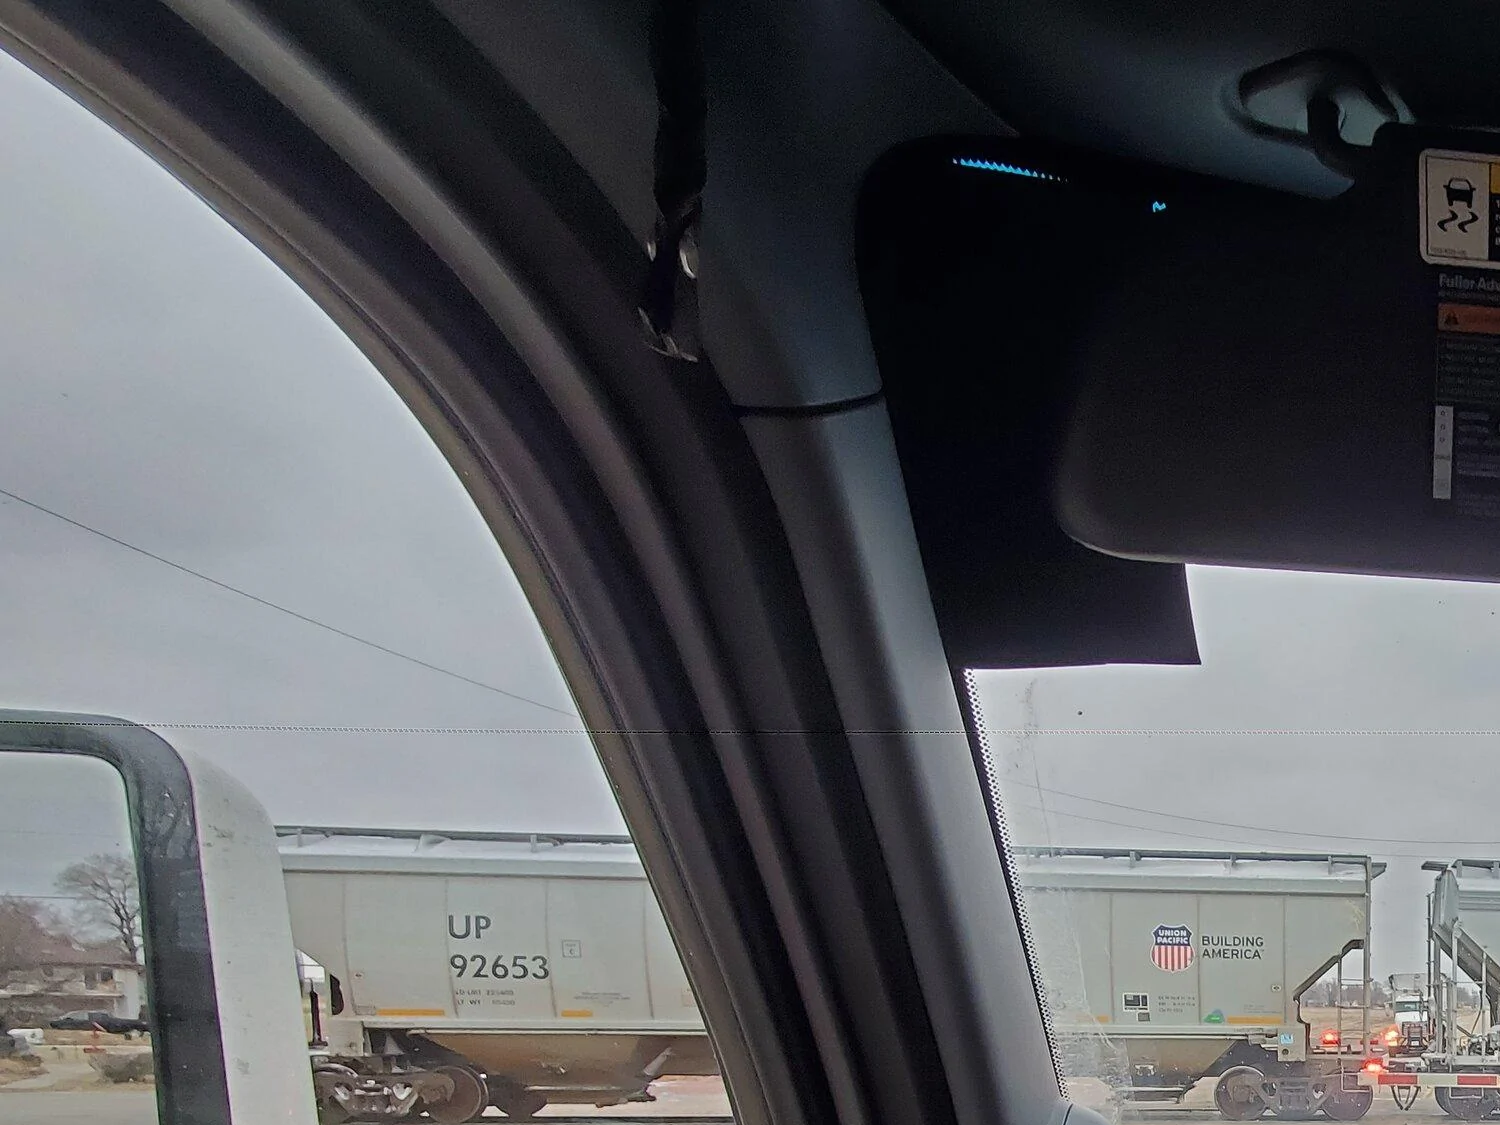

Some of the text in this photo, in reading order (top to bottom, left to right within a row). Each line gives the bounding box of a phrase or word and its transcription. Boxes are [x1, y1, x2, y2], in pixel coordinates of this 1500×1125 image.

[448, 914, 492, 940] UP
[1158, 928, 1188, 938] UNION
[1157, 935, 1190, 946] PACIFIC
[1201, 935, 1265, 948] BUILDING
[1202, 947, 1263, 960] AMERICA
[449, 954, 550, 980] 92653
